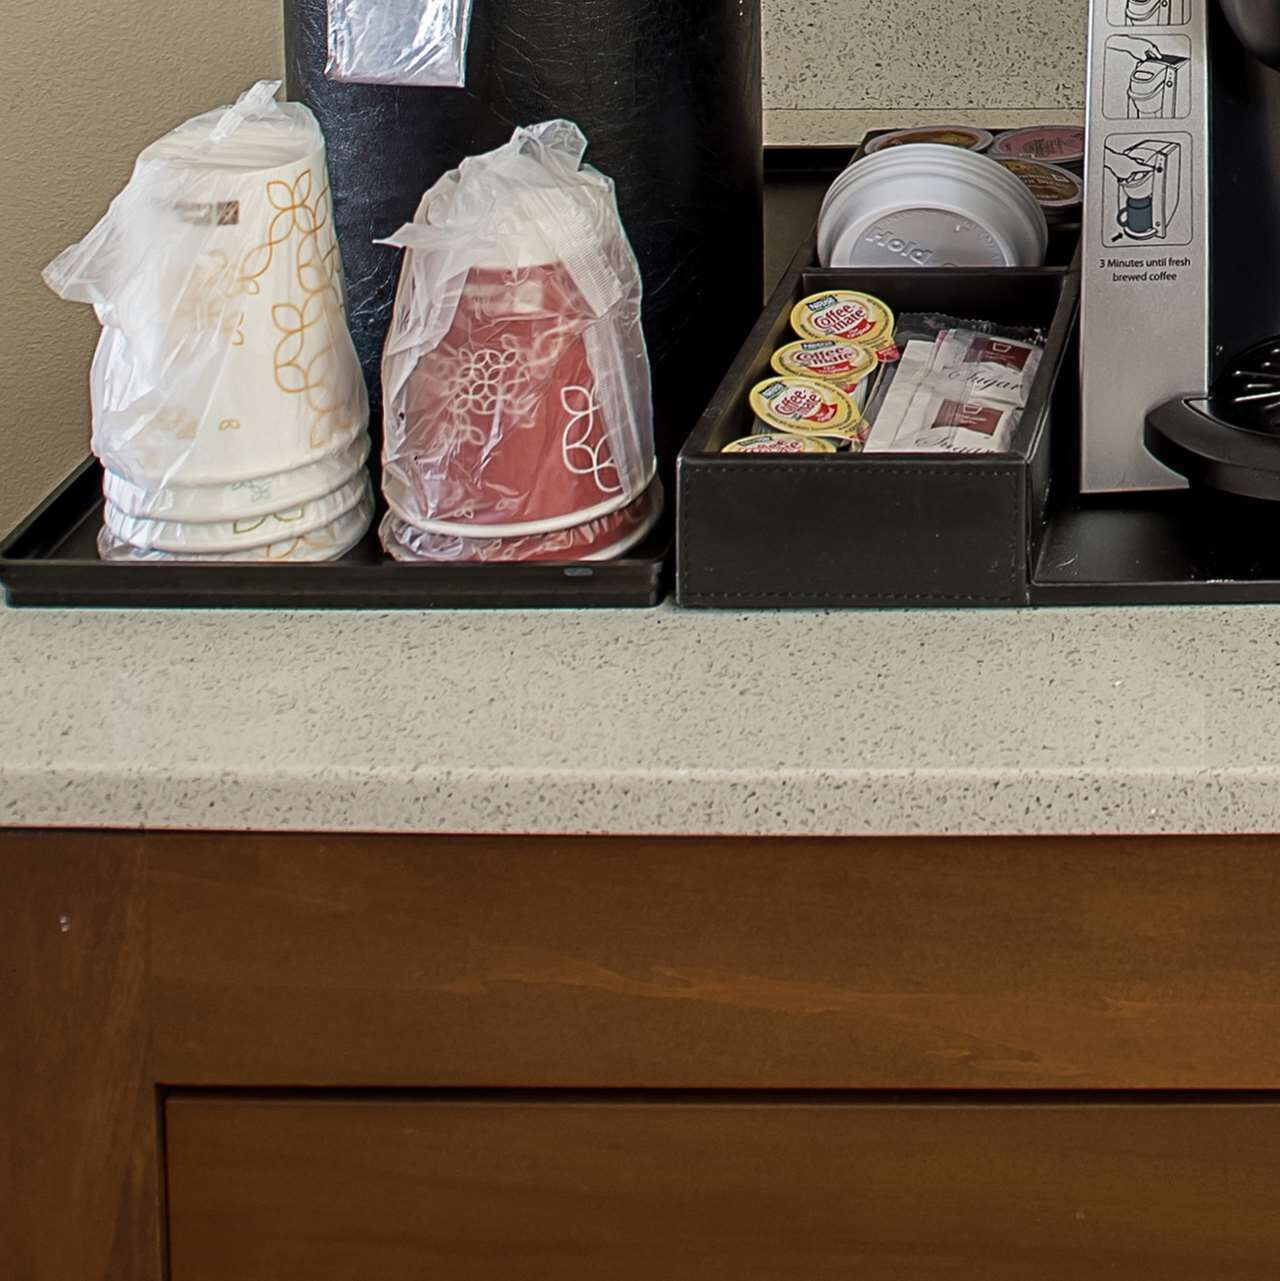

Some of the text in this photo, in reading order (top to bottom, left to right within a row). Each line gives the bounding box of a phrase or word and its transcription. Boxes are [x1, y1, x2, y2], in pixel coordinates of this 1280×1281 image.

[865, 226, 934, 265] Hold
[1100, 257, 1191, 268] 3 Minutes until fresh
[1112, 272, 1177, 281] brewed coffee
[942, 366, 1023, 391] Sugar
